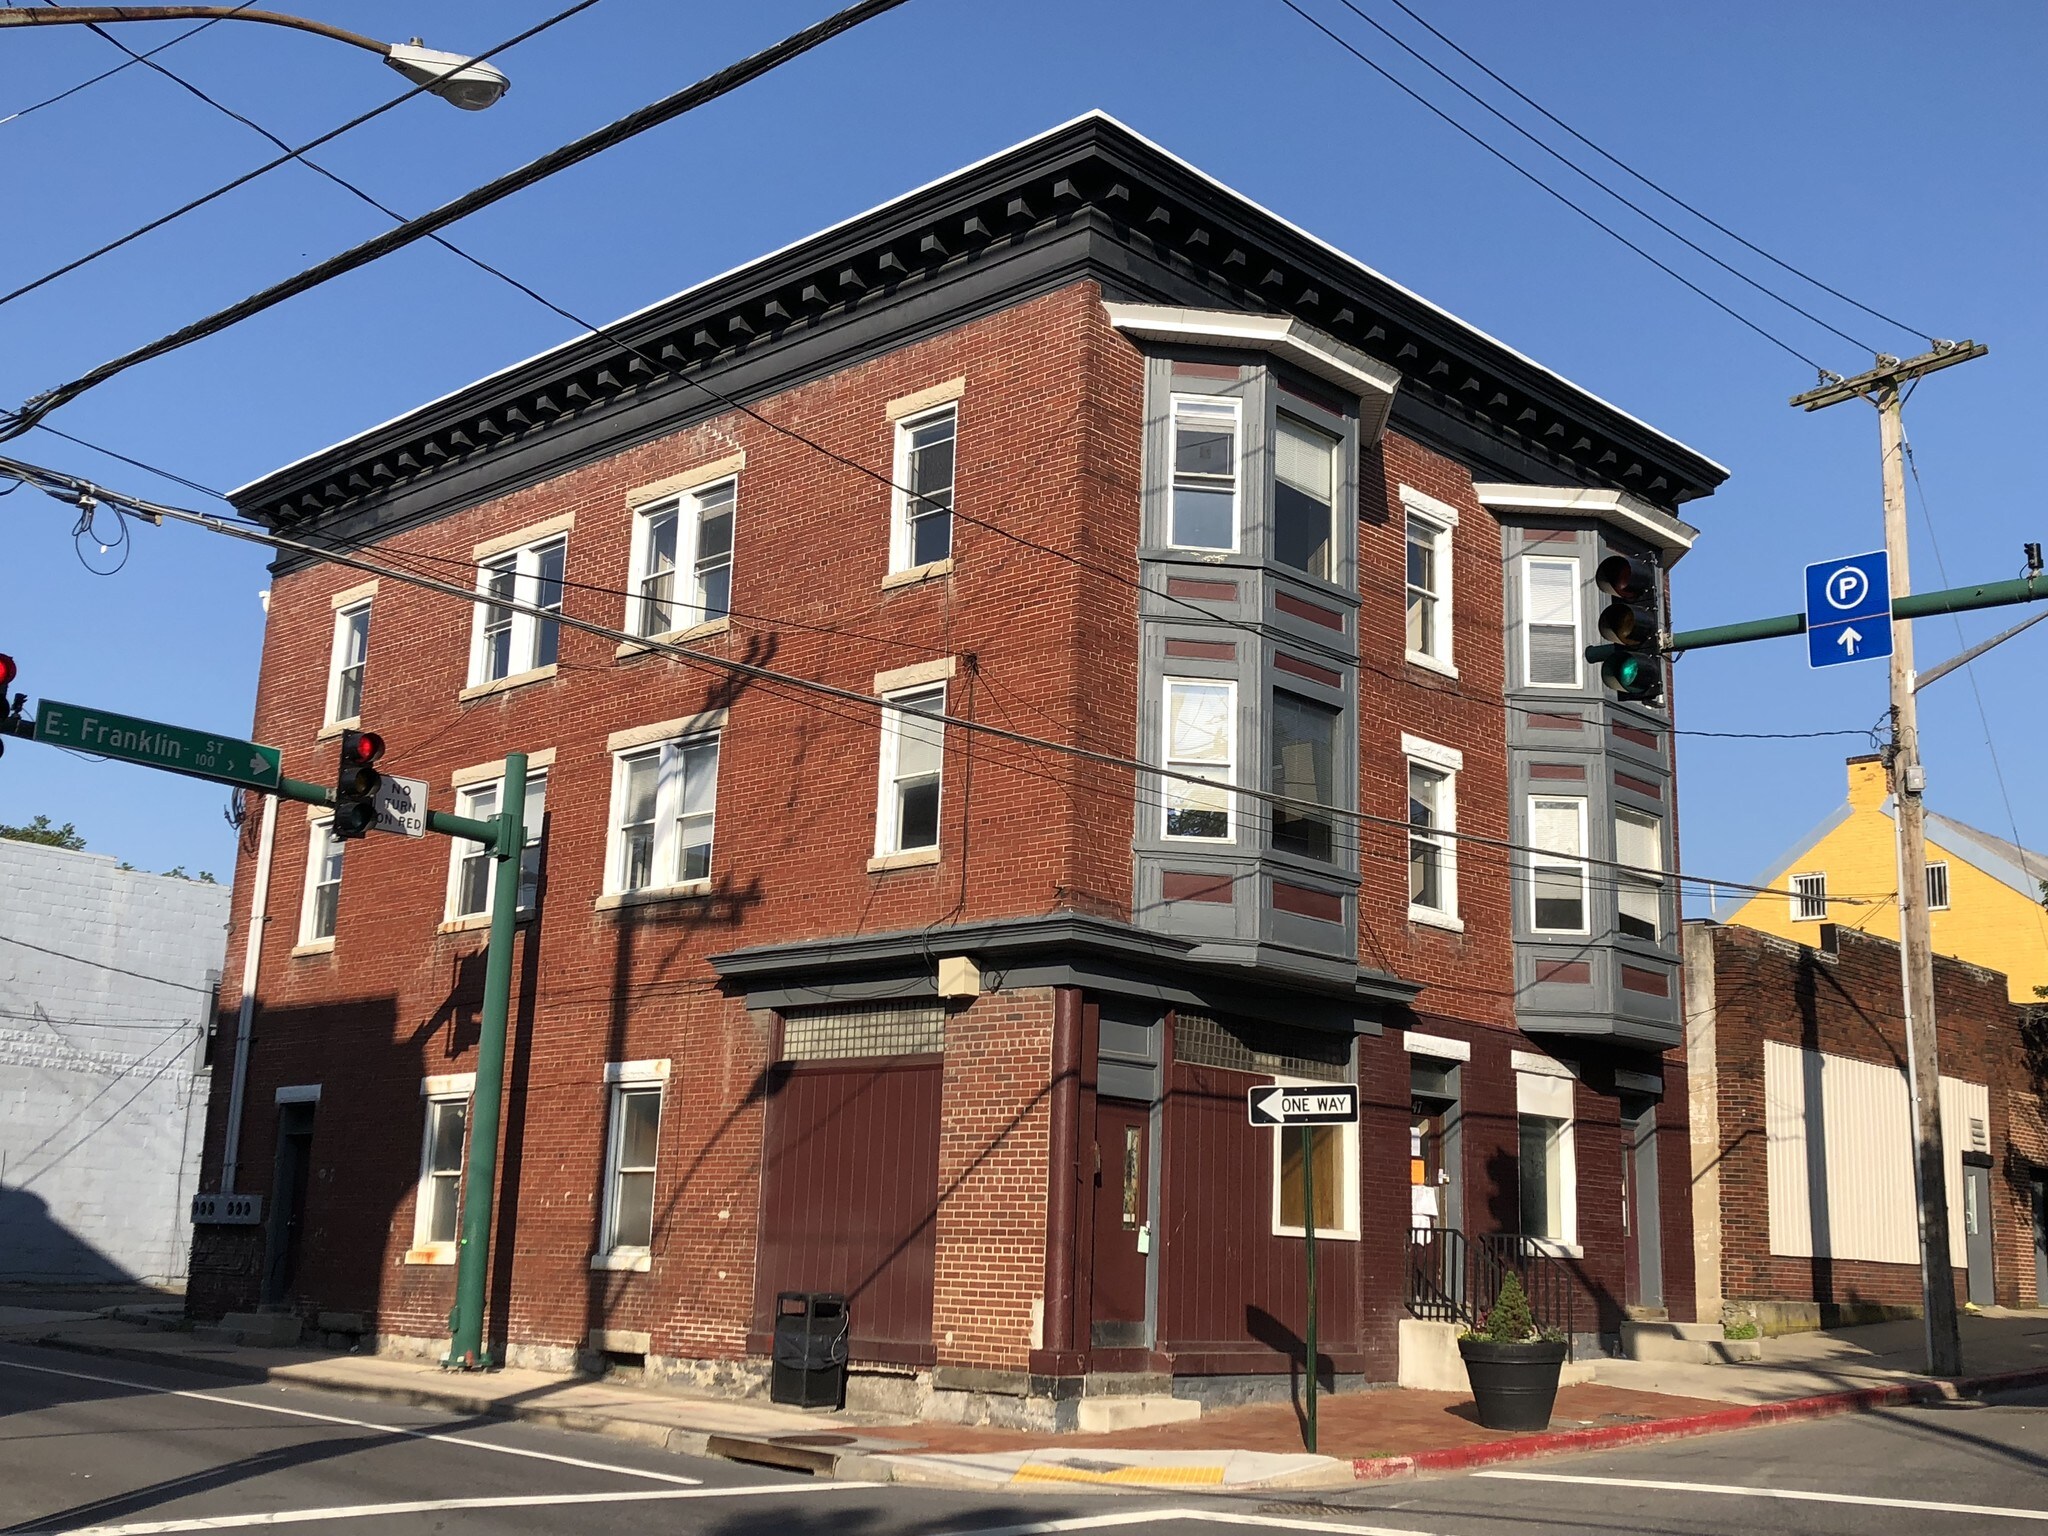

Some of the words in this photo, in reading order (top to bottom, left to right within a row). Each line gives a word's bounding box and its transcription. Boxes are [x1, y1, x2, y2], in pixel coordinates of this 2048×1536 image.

[1839, 576, 1858, 600] P
[81, 717, 181, 759] Franklin
[206, 740, 224, 755] ST
[195, 753, 216, 768] 100
[391, 783, 411, 797] NO
[384, 797, 417, 813] TURN
[376, 812, 393, 825] ON
[398, 816, 422, 830] RED
[1281, 1098, 1310, 1113] ONE
[1317, 1096, 1347, 1112] WAY
